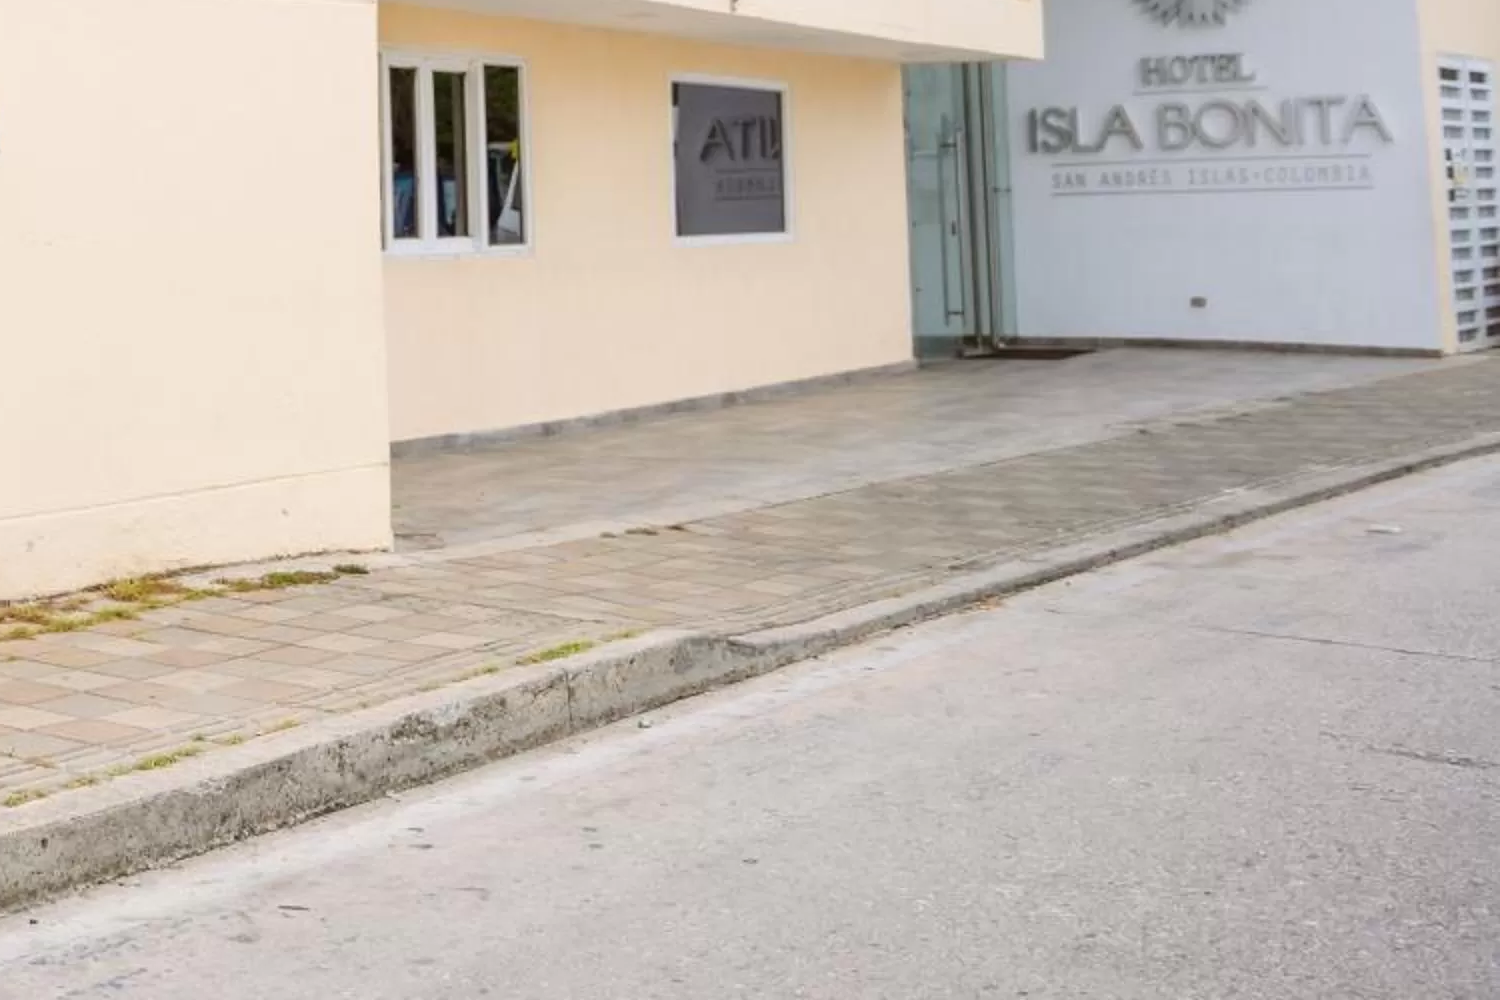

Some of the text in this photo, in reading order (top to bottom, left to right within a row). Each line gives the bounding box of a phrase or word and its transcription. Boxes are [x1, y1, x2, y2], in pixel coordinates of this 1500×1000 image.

[1139, 53, 1256, 86] HOTEL
[1027, 93, 1394, 153] ISLA BONITA
[1051, 171, 1087, 189] SAN
[1187, 167, 1249, 185] ISLAS
[1263, 164, 1371, 184] COLOMBIA
